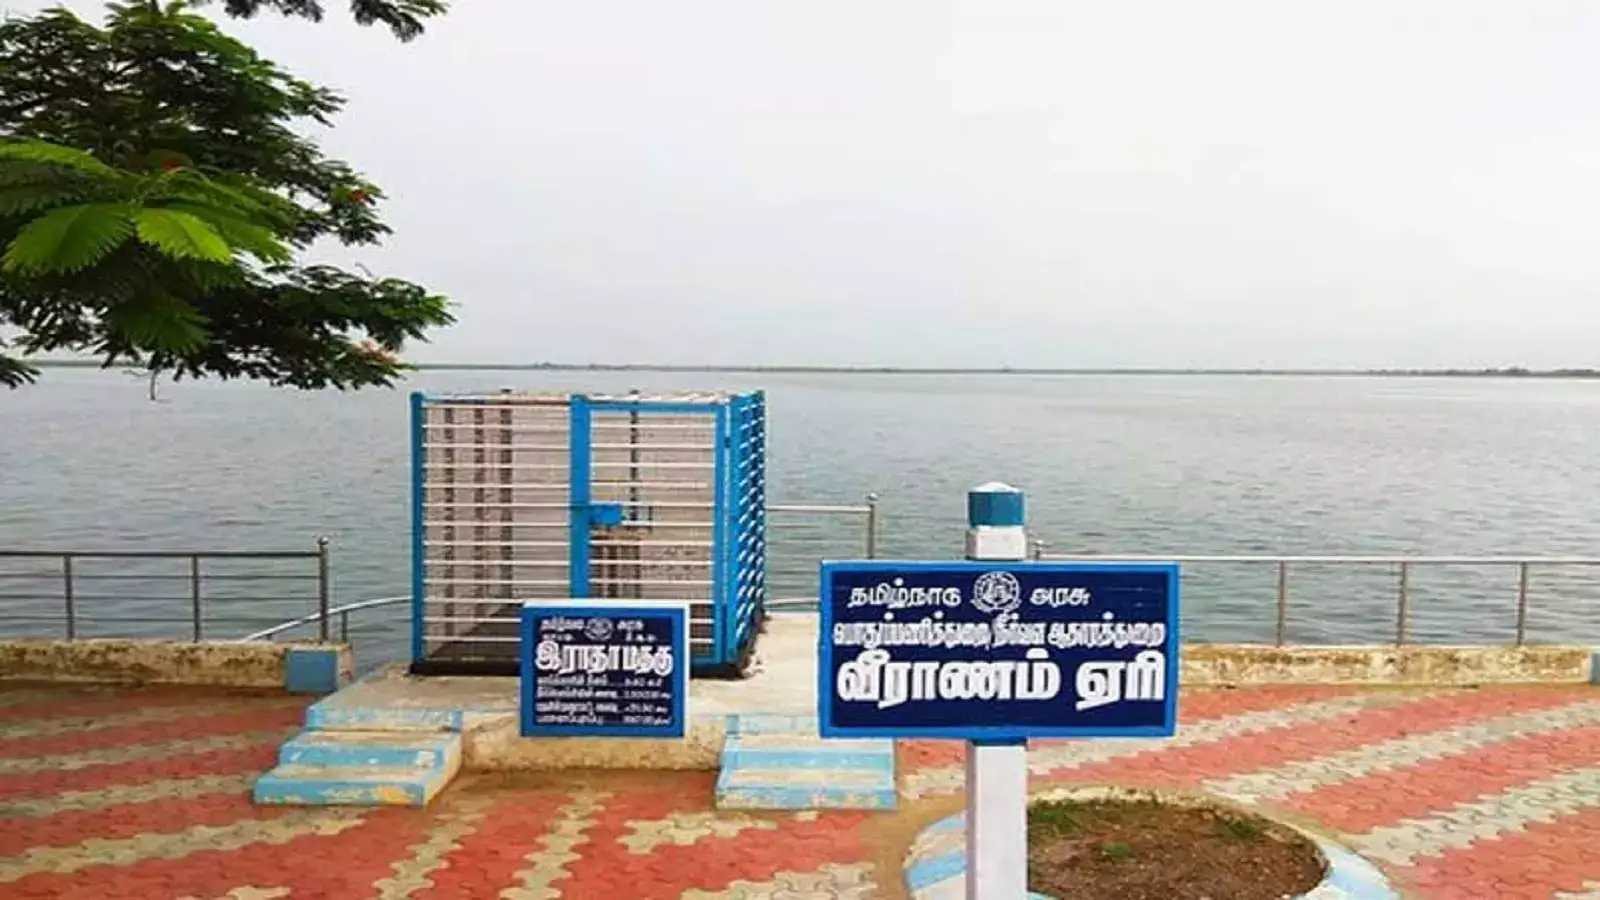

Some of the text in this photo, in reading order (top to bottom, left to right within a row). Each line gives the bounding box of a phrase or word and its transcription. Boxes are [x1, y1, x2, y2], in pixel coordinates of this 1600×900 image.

[848, 578, 1091, 608] தமிழ்நாடு அரசு
[837, 648, 1166, 711] வீராணம் ஏரி
